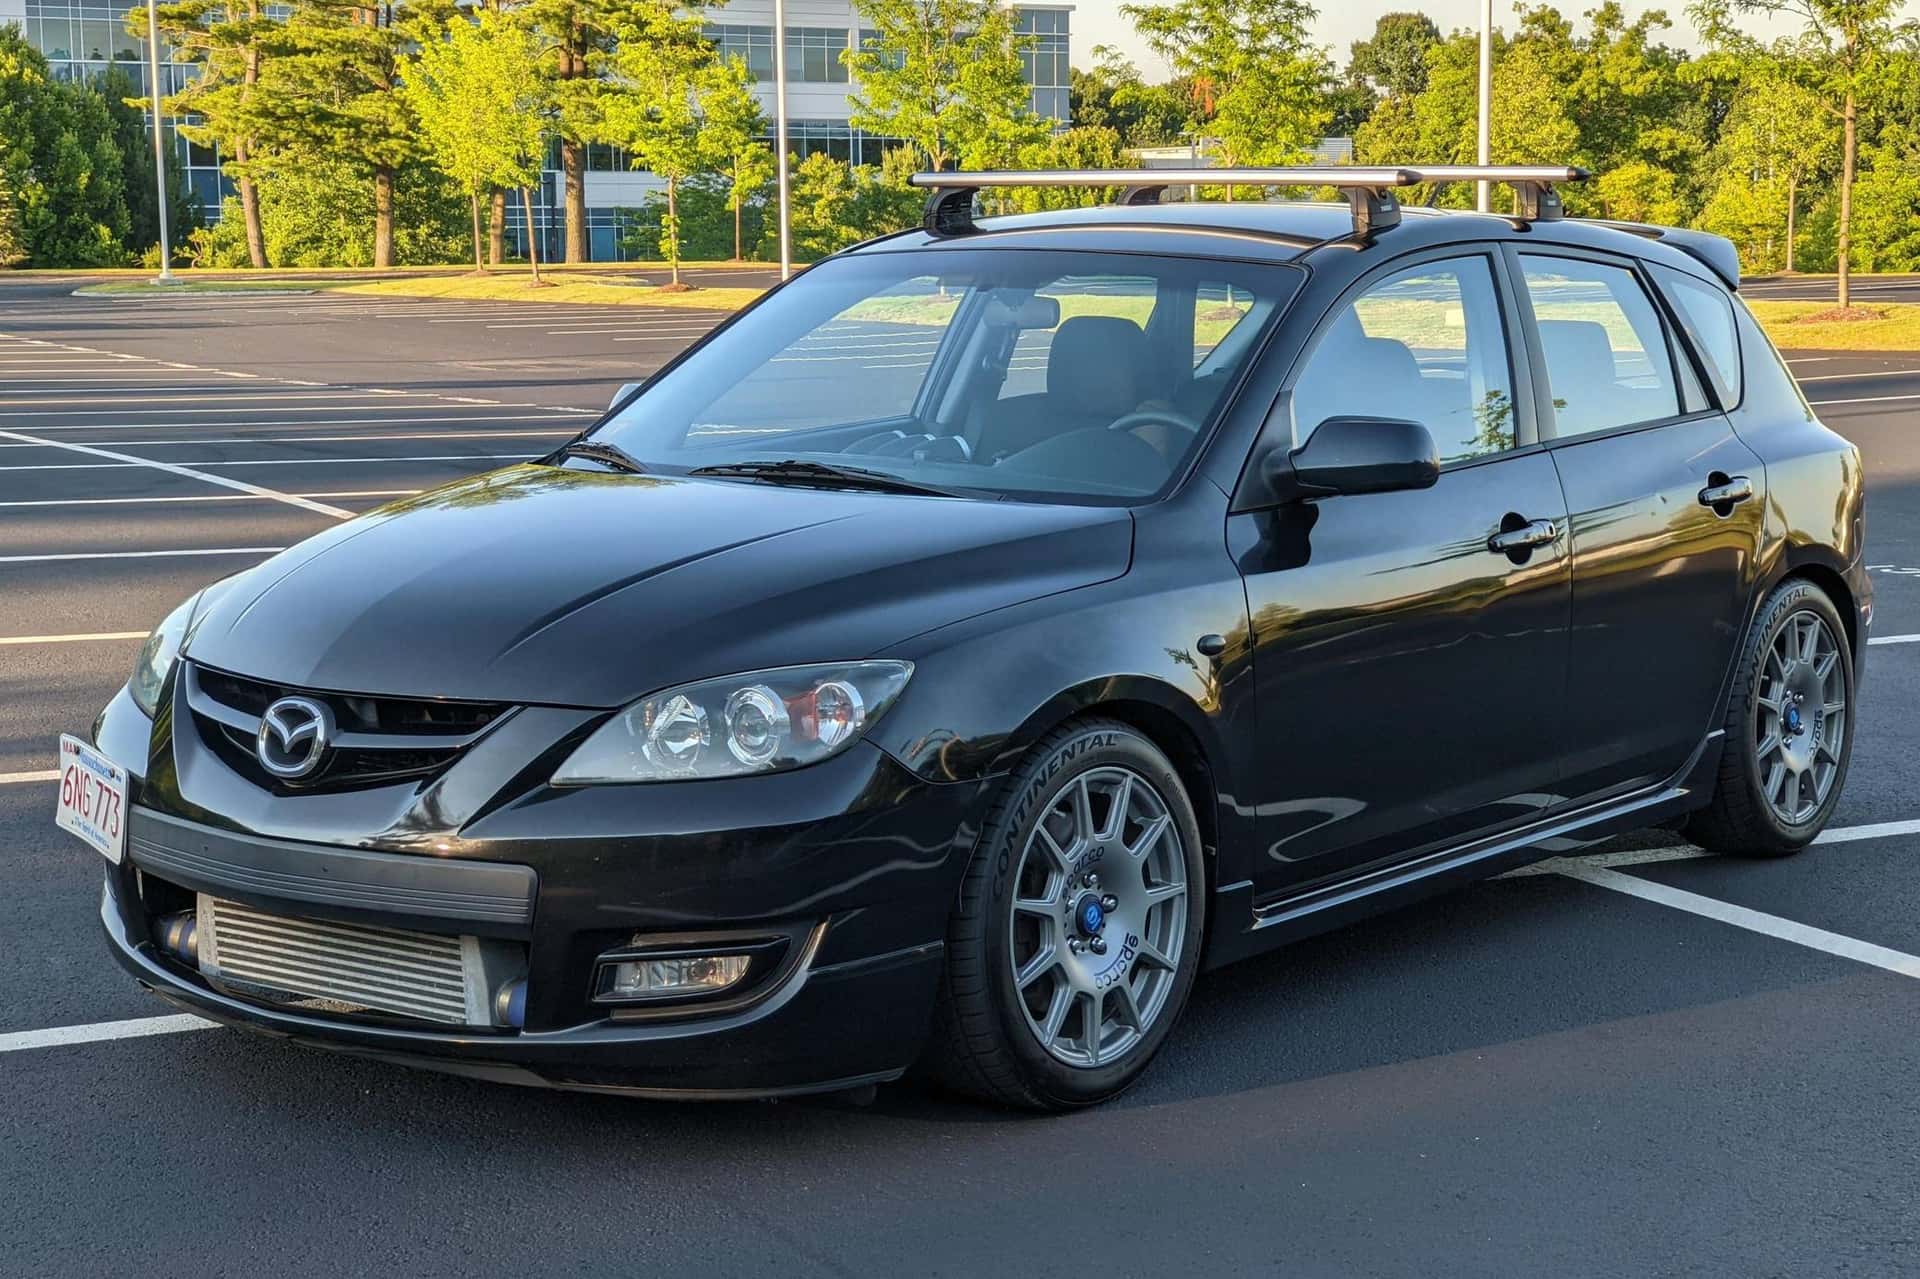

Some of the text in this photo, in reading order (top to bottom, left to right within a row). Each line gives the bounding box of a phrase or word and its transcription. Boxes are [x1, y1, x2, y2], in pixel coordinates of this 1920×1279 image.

[63, 764, 120, 838] 6NG 773
[992, 733, 1117, 897] CONTINENTAL
[1095, 935, 1139, 989] sparco
